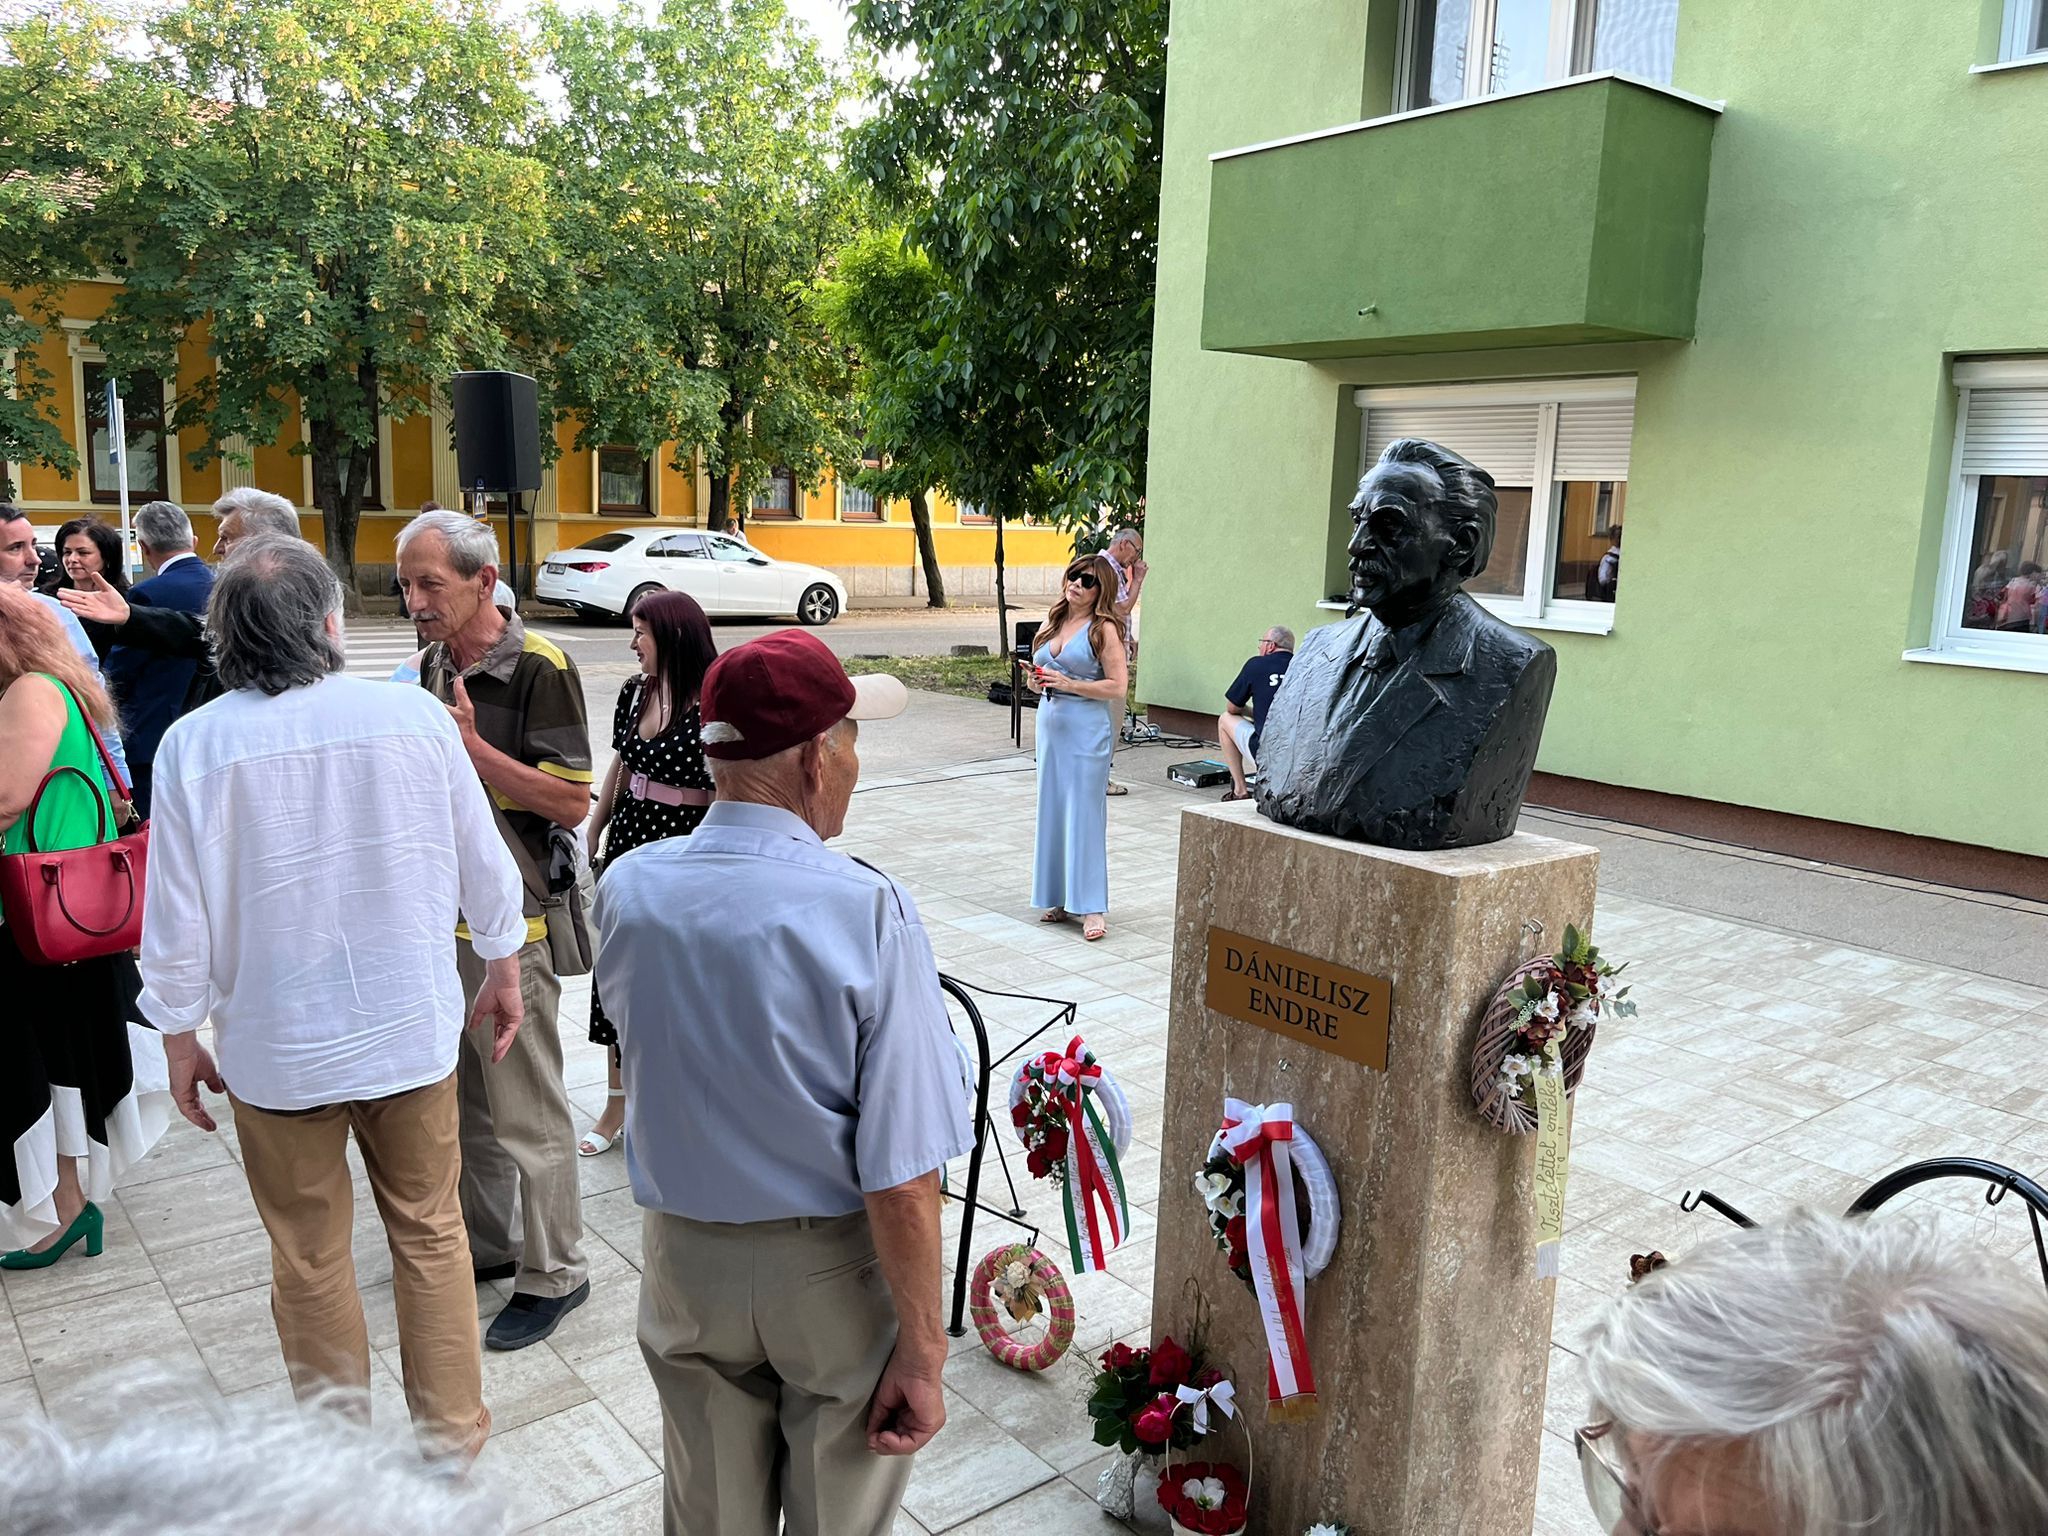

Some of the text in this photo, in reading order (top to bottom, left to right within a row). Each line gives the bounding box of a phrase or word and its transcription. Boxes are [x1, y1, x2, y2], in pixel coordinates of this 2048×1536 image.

[1224, 947, 1371, 1017] DÁNIELISZ
[1248, 987, 1339, 1041] ENDRE
[1536, 1141, 1560, 1233] Tisztelettel
